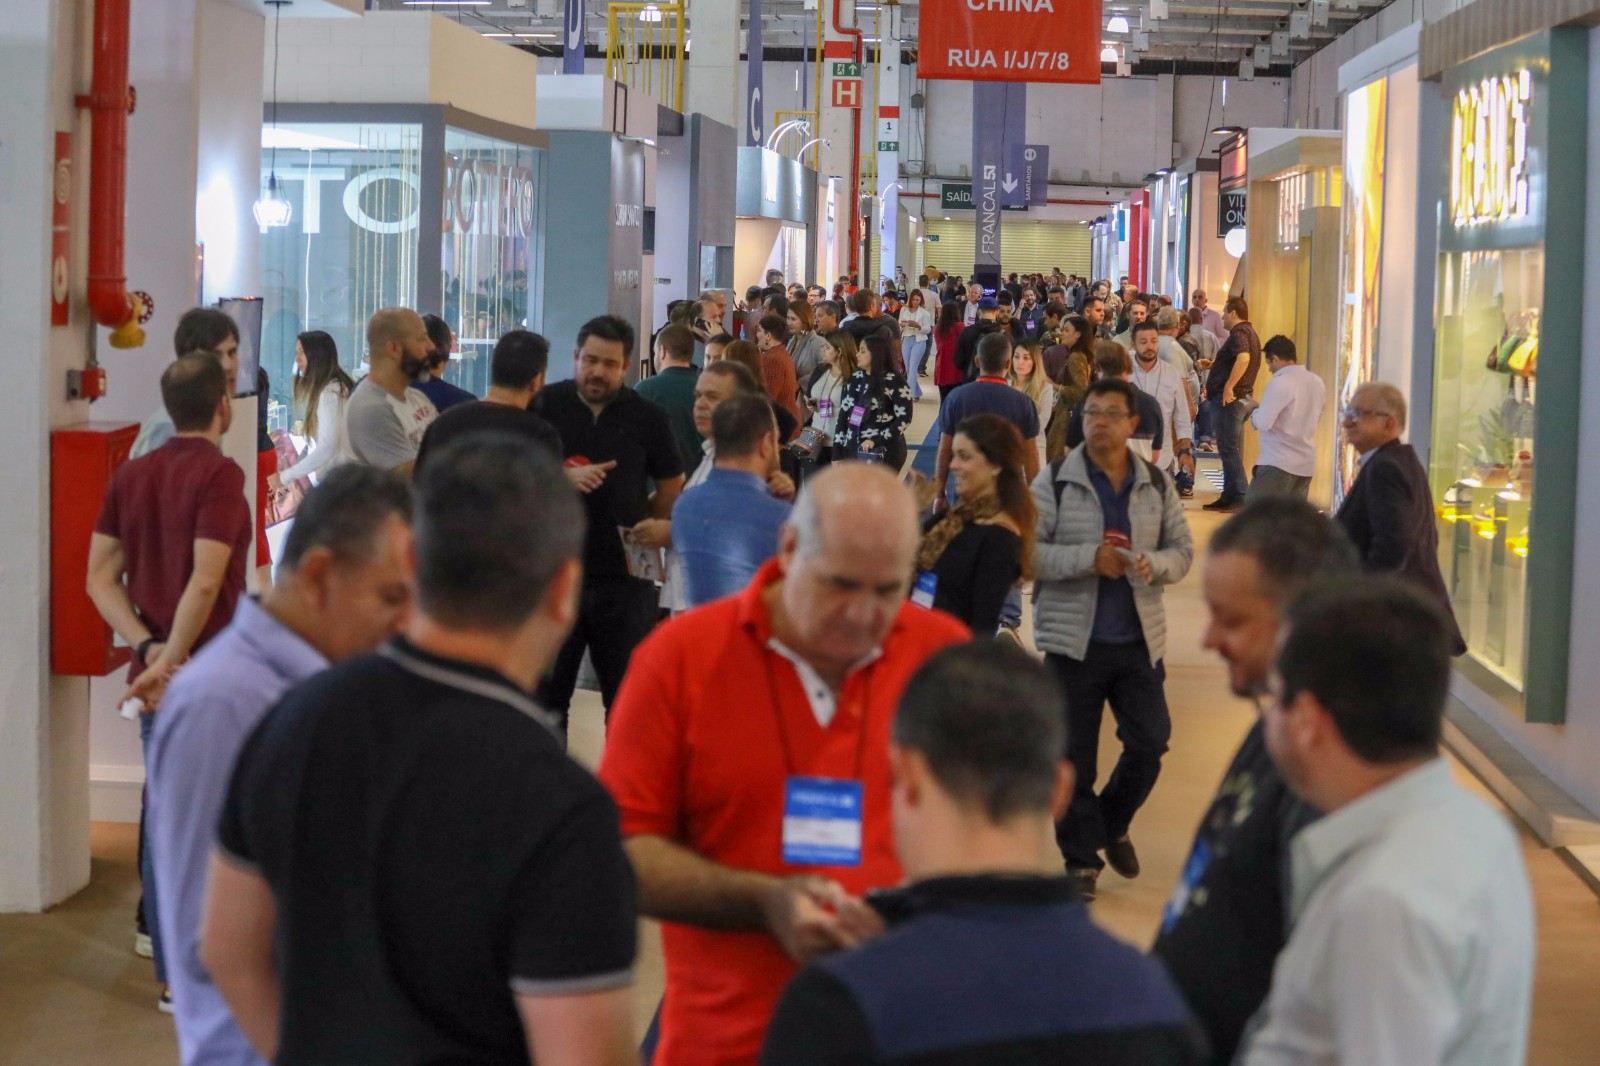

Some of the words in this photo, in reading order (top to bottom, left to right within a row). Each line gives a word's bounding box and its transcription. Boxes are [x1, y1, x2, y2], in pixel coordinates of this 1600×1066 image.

[967, 0, 1054, 12] CHINA
[948, 49, 997, 68] RUA
[1004, 51, 1069, 70] I/J/7/8
[836, 82, 856, 105] H
[751, 87, 761, 142] C
[946, 190, 972, 202] SAÍD
